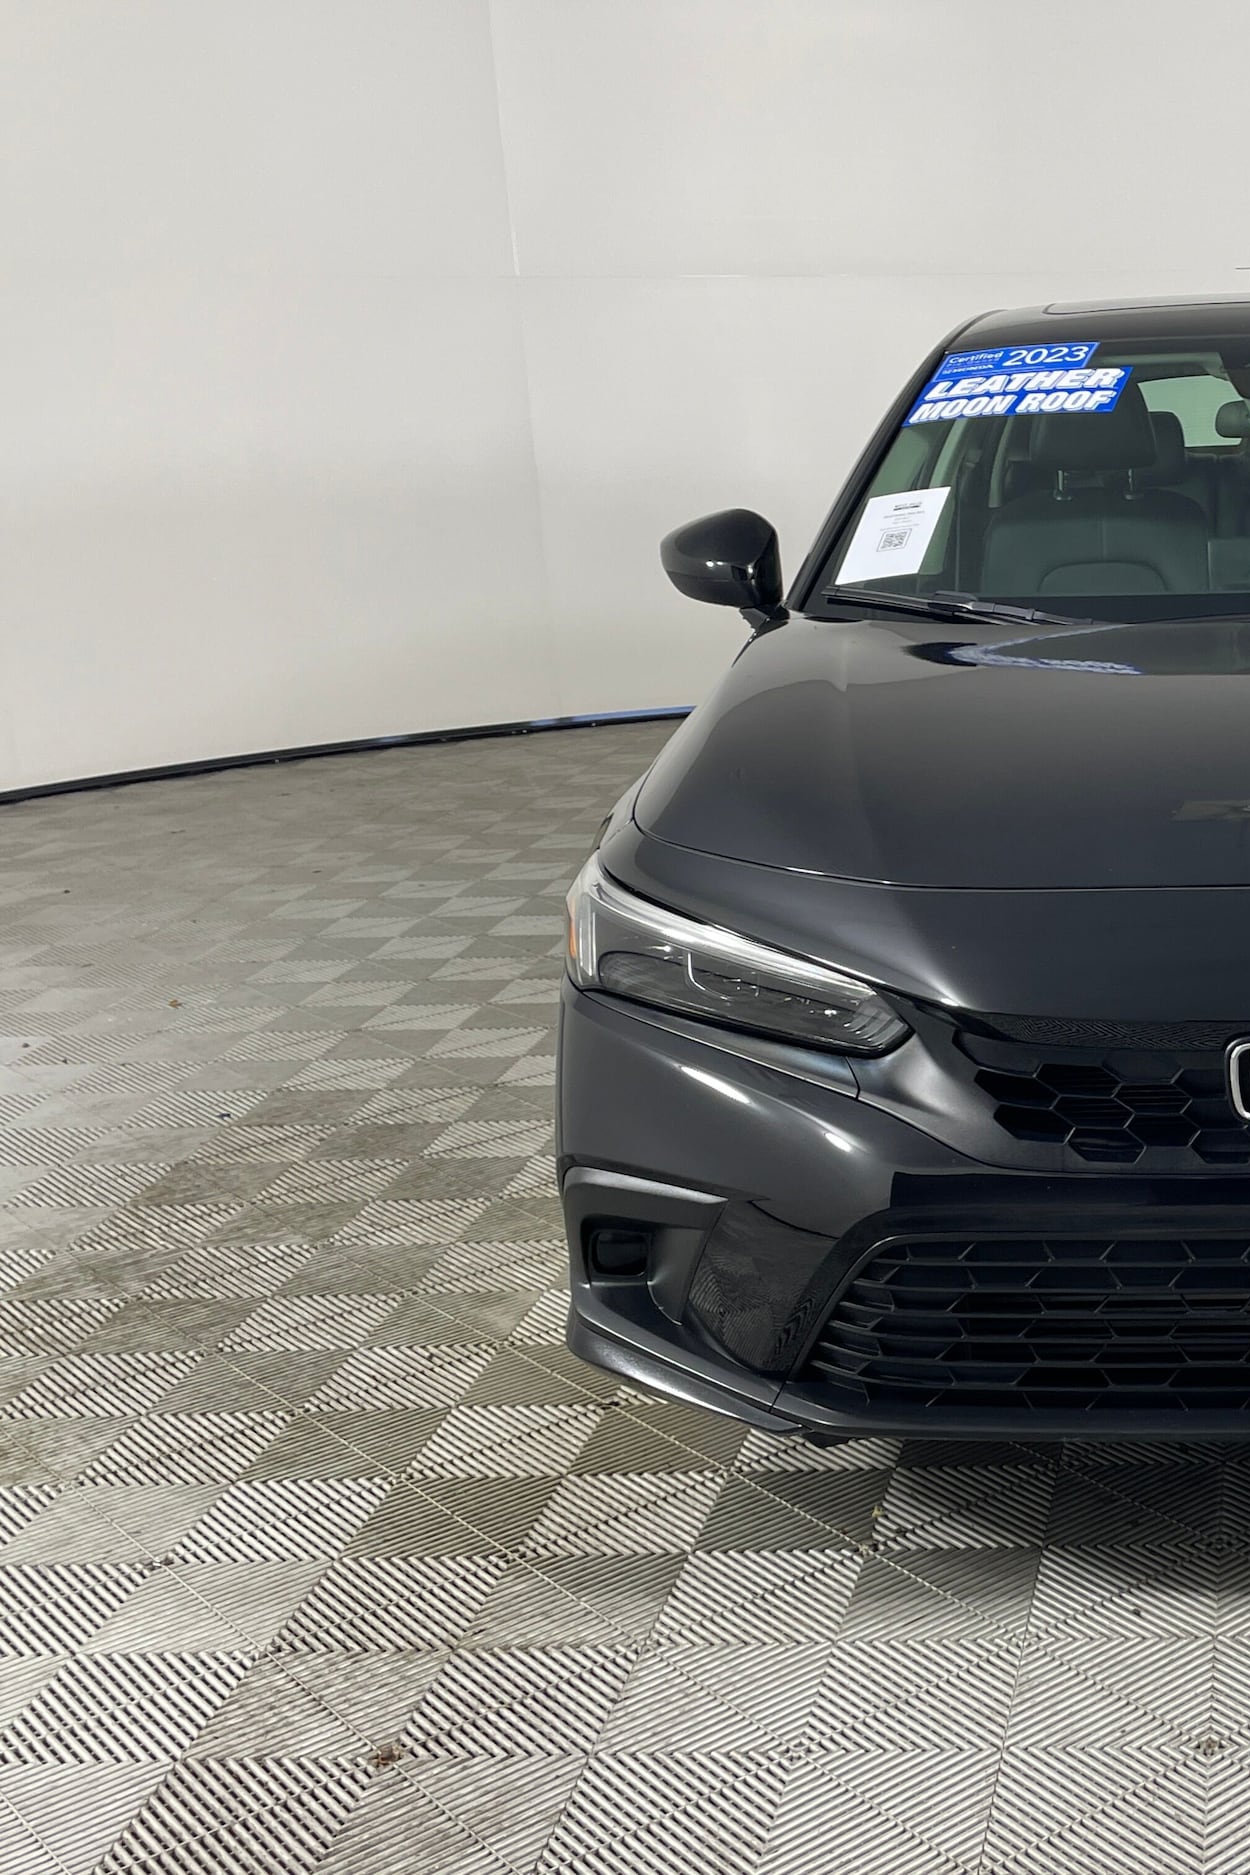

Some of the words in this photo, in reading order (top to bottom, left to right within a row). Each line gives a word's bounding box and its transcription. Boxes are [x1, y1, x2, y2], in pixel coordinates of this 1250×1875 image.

[948, 351, 1004, 364] Certified
[1002, 346, 1089, 367] 2023
[924, 368, 1125, 401] LEATHER
[910, 395, 1017, 424] MOON
[1015, 391, 1117, 413] ROOF
